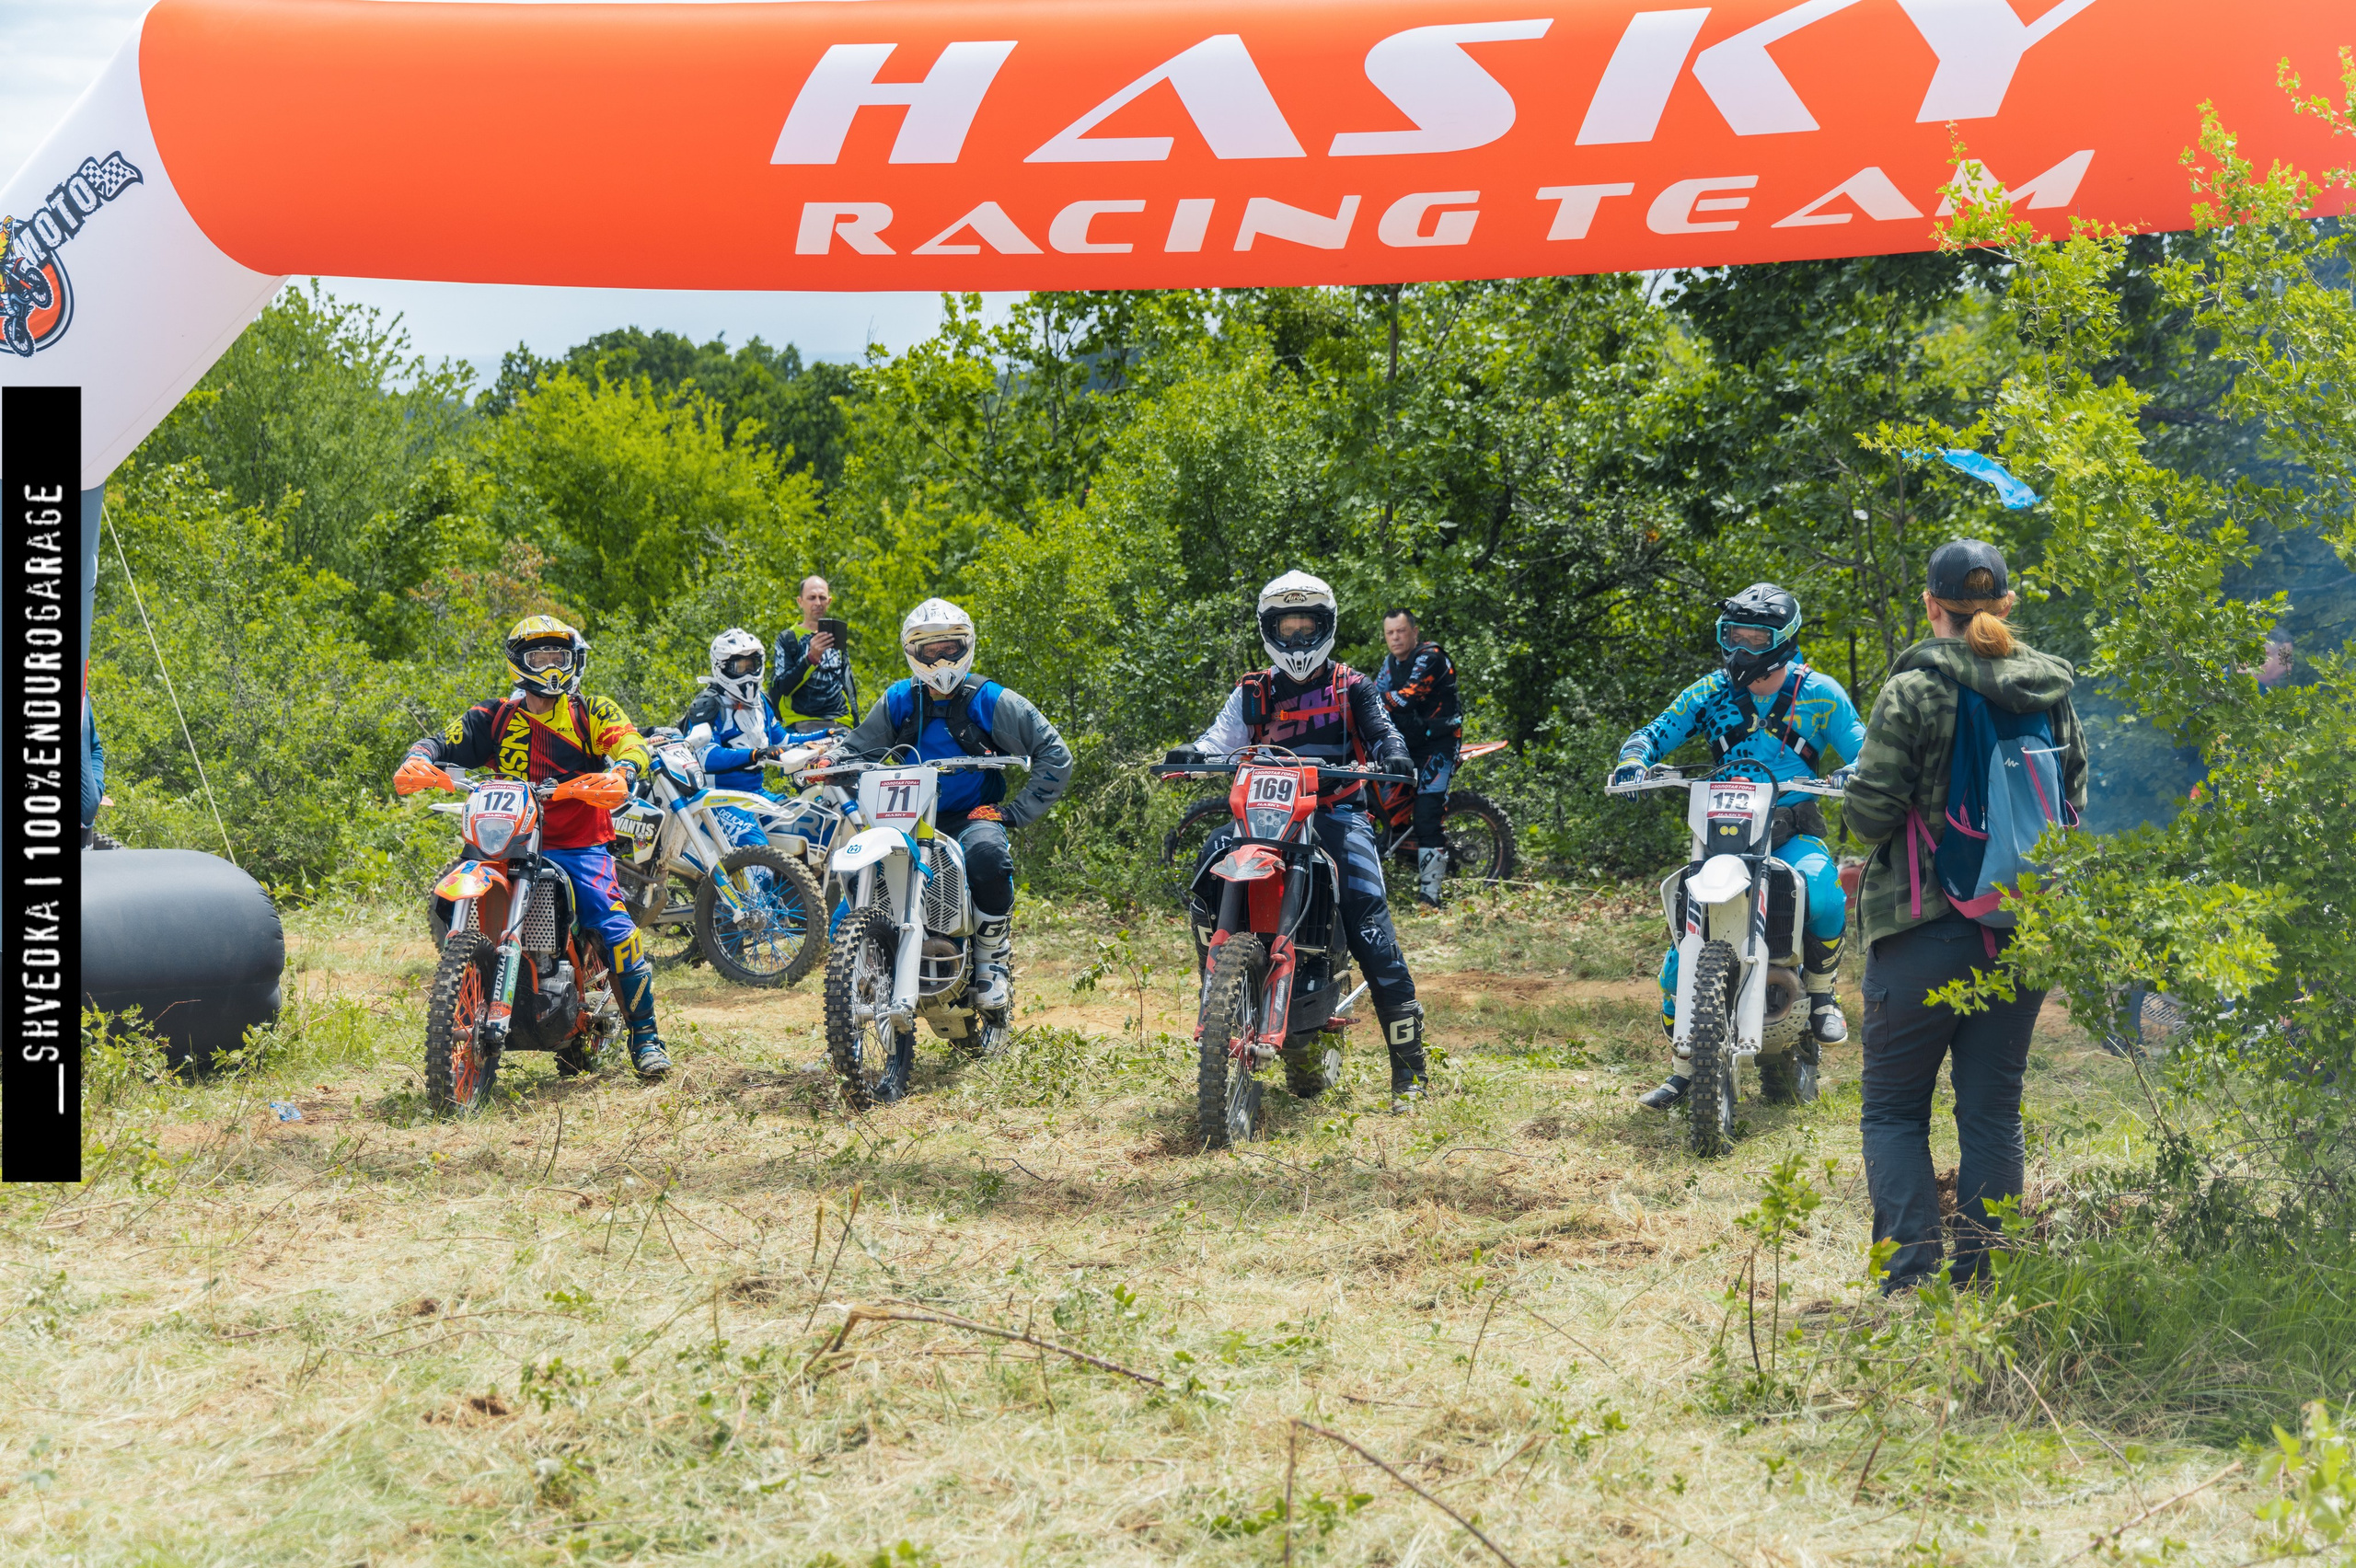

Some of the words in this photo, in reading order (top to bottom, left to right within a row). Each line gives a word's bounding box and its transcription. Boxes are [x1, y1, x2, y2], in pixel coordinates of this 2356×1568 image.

[770, 0, 2096, 164] HASKY
[795, 191, 1480, 254] RACING
[1536, 150, 2095, 240] TEAM
[15, 176, 98, 273] MOTO
[484, 791, 515, 812] 172
[887, 786, 910, 812] 71
[1253, 778, 1293, 802] 169
[1714, 792, 1750, 810] 173
[613, 817, 655, 837] VANTIS
[507, 947, 522, 991] MOTOREX
